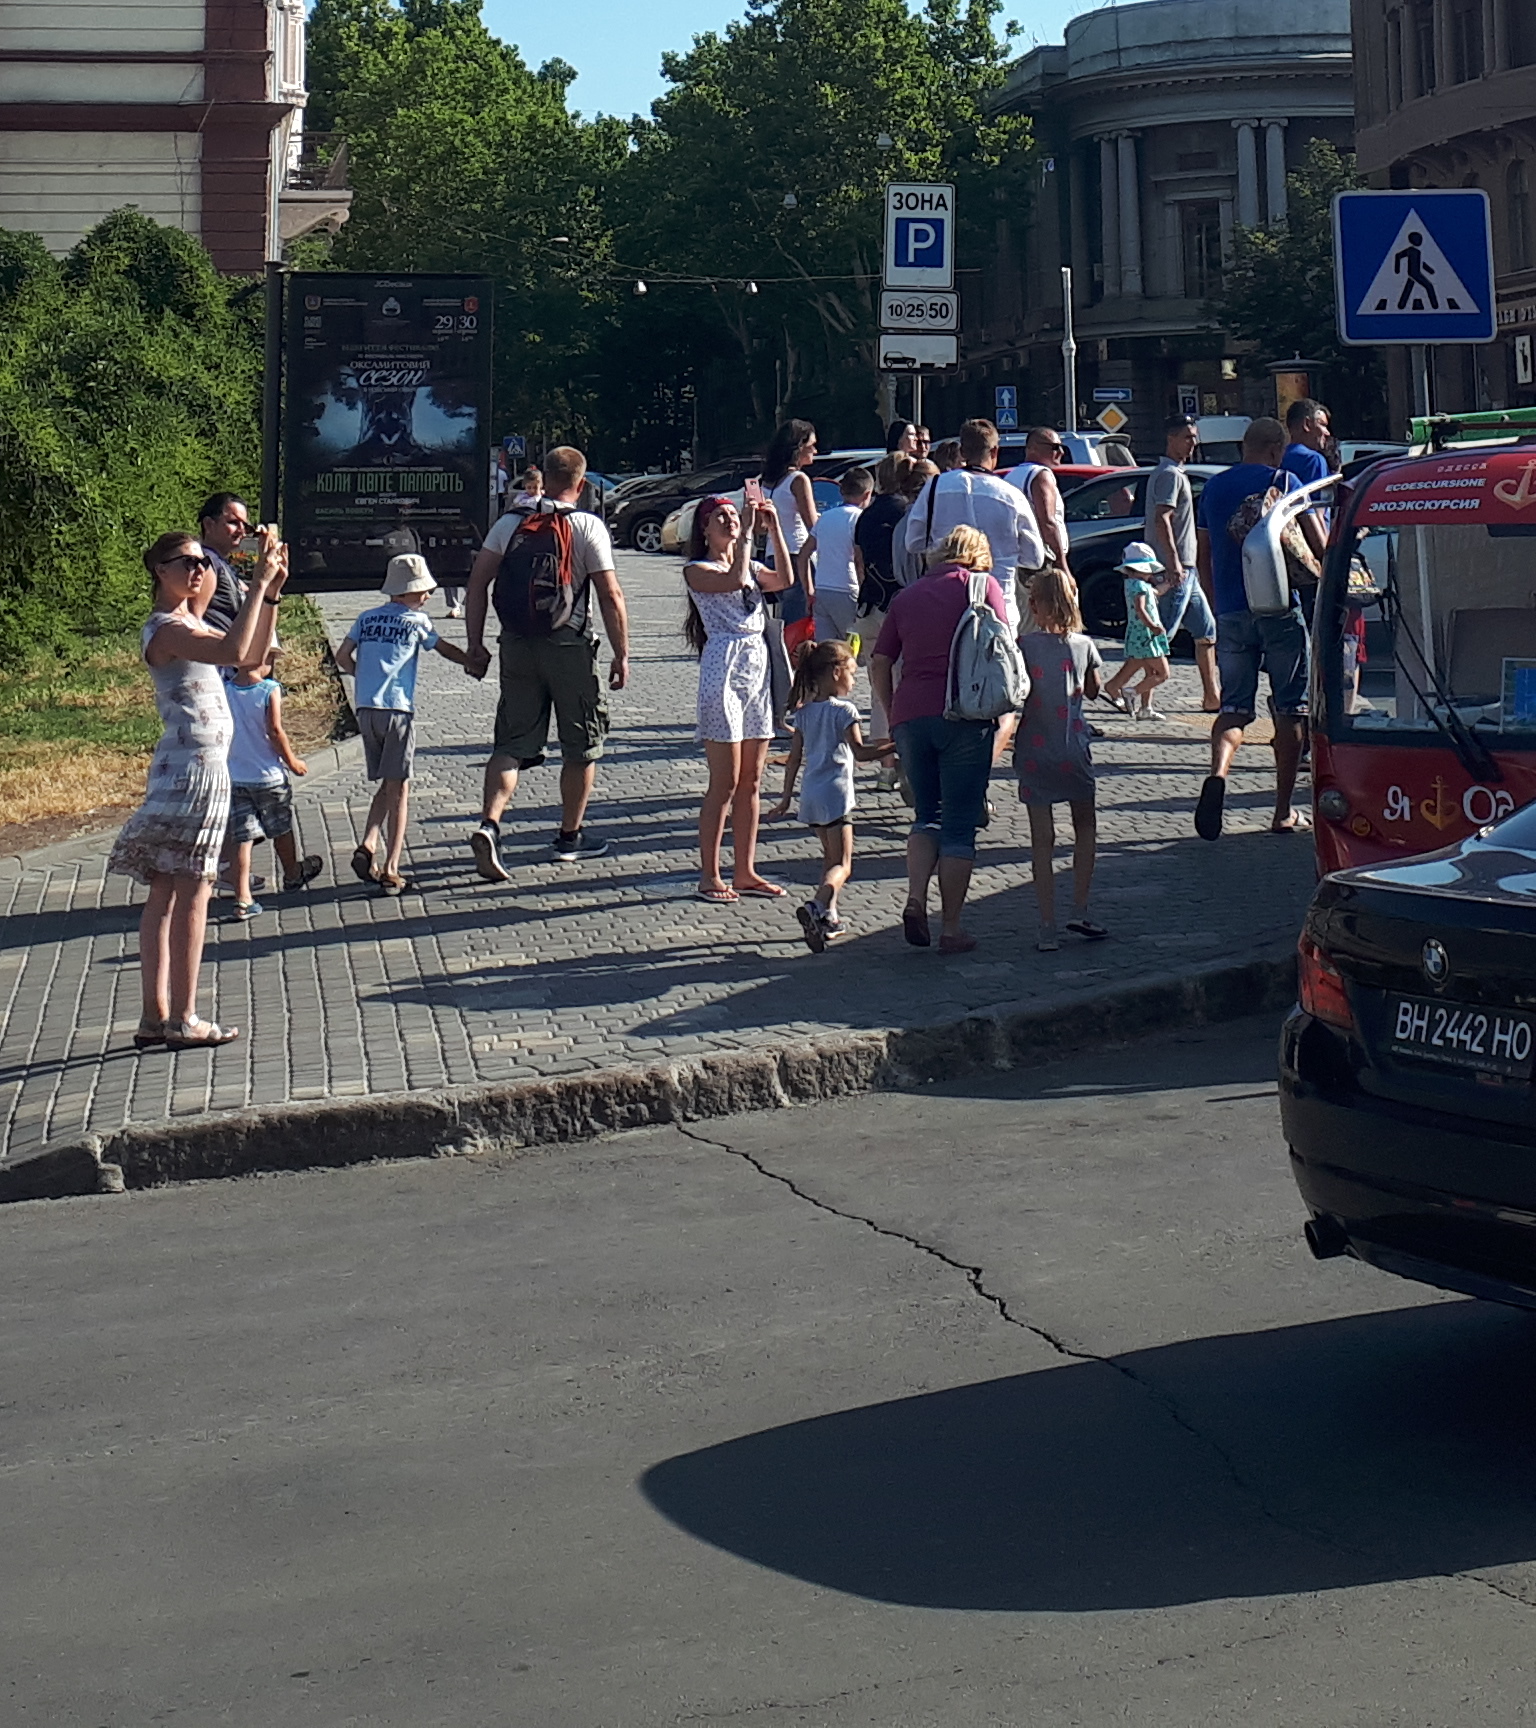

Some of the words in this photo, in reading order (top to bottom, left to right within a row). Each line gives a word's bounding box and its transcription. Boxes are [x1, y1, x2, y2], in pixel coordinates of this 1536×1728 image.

[892, 192, 949, 212] ЗОНА
[888, 304, 903, 318] 10
[905, 303, 925, 318] 25
[928, 302, 950, 319] 50
[434, 315, 453, 329] 29
[459, 315, 477, 329] 30
[316, 473, 351, 492] КОЛИ
[357, 473, 393, 494] ЦВІТЕ
[399, 473, 464, 492] ПАПОРОТЬ
[1385, 477, 1487, 493] ECOESCURSIONE
[1368, 498, 1481, 513] ЭКОЭКСКУРСИЯ
[1431, 1008, 1488, 1054] 2442
